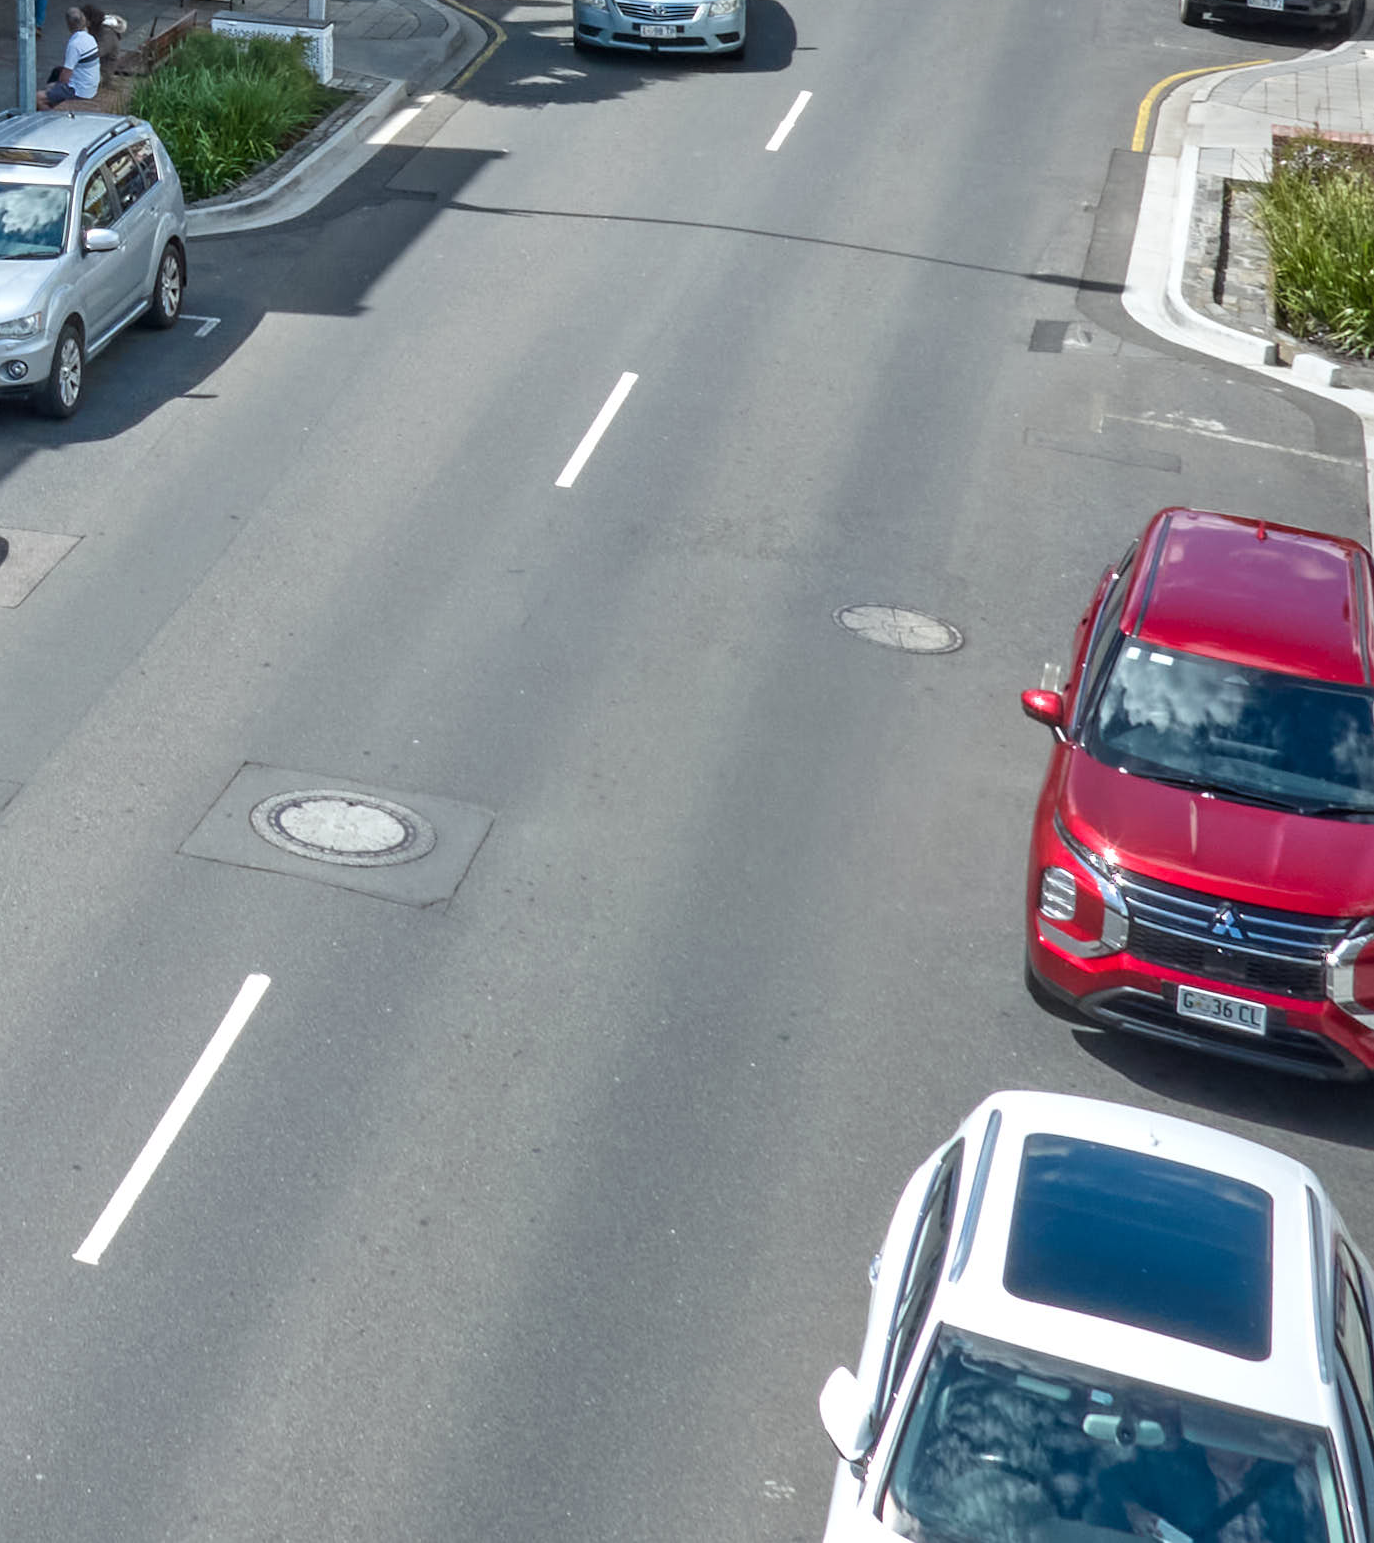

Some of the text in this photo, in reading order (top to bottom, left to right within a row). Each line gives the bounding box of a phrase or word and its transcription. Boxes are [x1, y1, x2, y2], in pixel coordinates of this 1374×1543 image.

[1183, 992, 1261, 1027] G 36 CL
